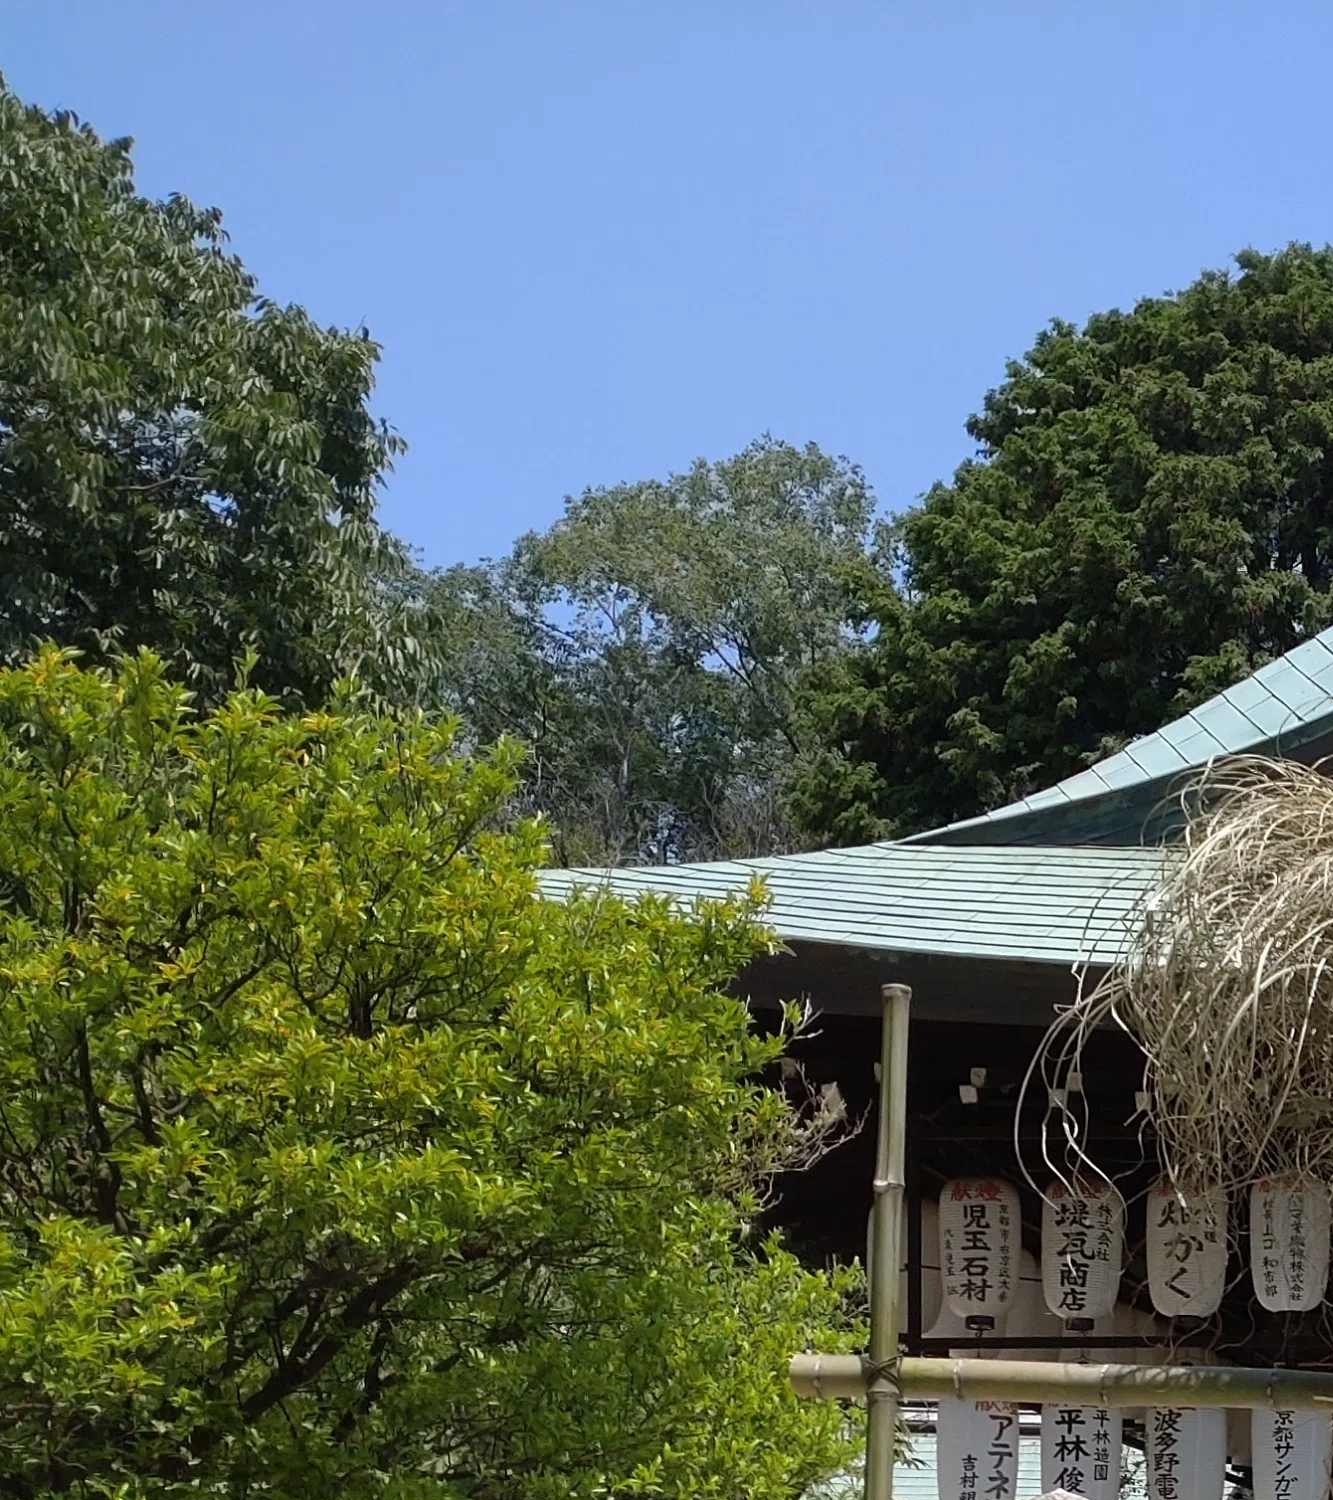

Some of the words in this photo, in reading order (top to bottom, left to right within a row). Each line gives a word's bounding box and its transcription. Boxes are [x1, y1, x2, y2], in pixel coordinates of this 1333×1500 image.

[959, 1204, 994, 1302] 児玉石材
[1054, 1200, 1096, 1311] 堤瓦商店
[1097, 1202, 1114, 1262] 株式会社
